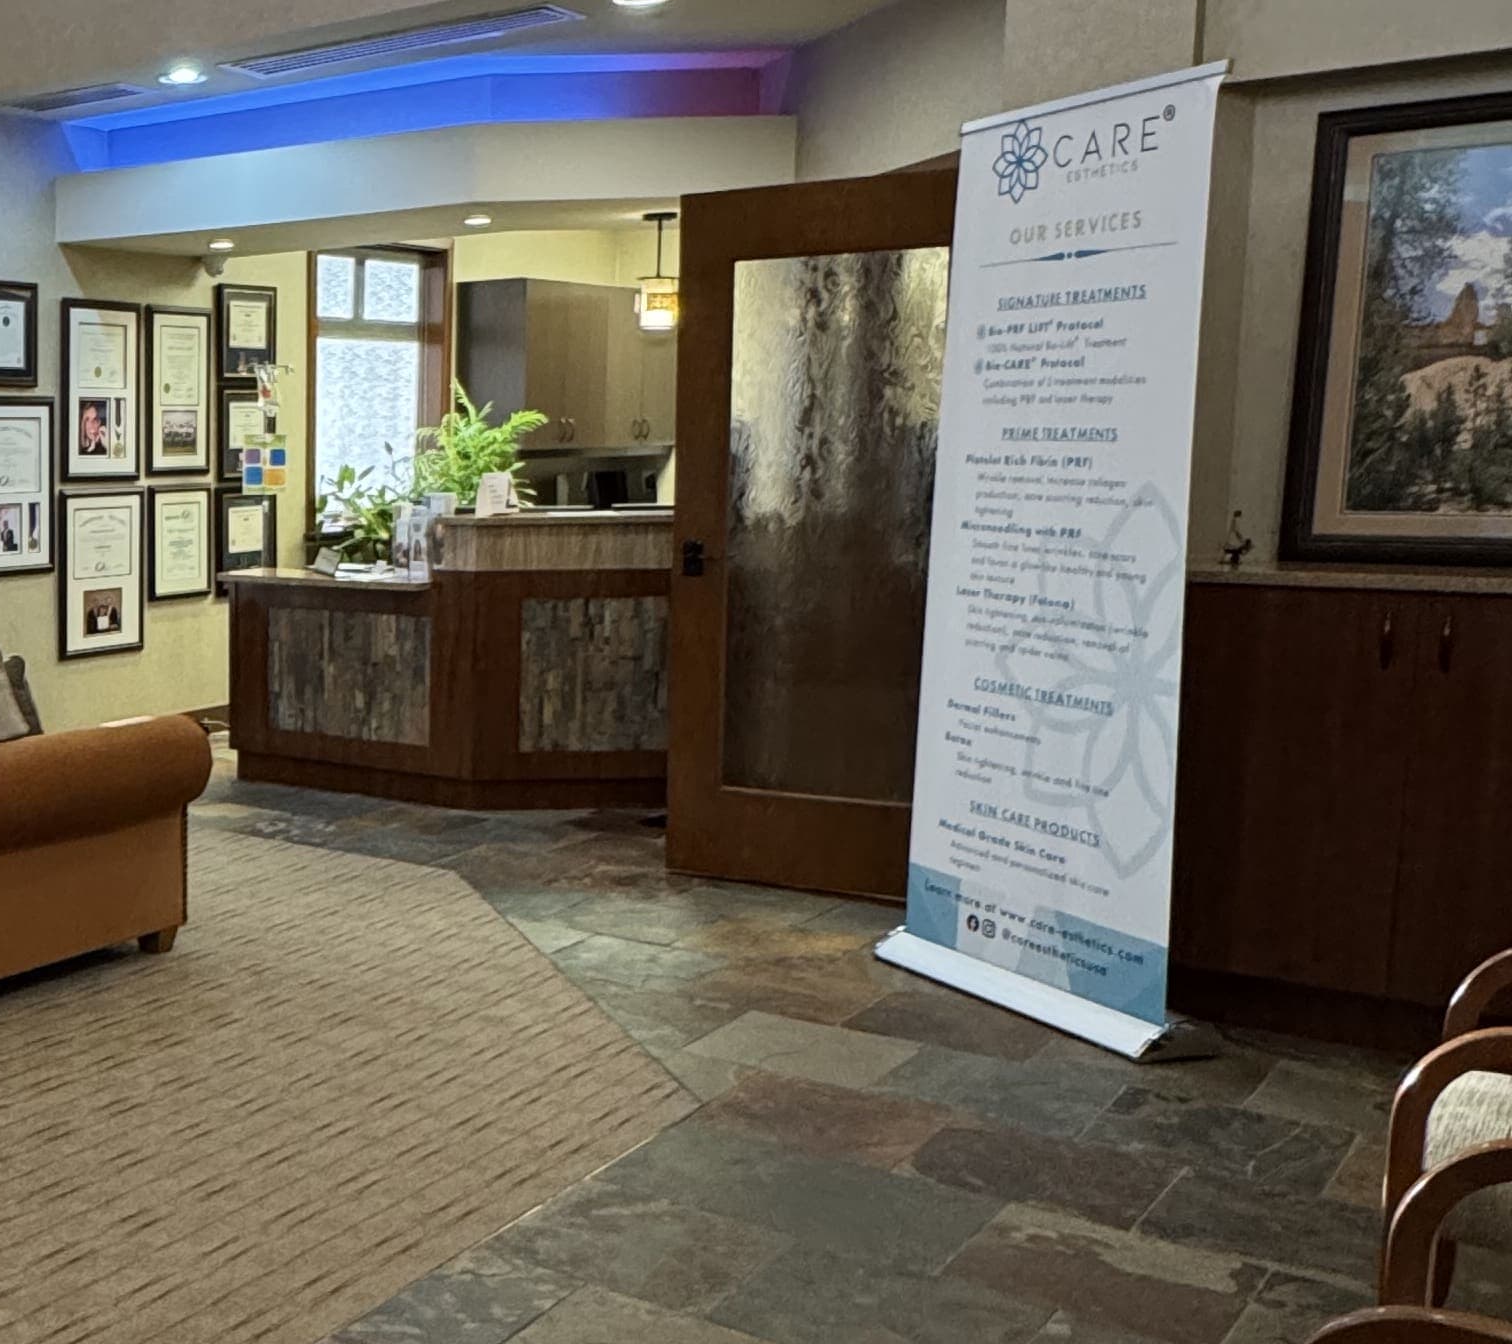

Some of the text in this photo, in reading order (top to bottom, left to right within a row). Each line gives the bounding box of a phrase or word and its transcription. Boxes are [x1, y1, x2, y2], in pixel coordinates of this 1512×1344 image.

[1066, 160, 1138, 183] ESTHETICS
[1009, 211, 1142, 245] OUR SERVICES
[997, 284, 1148, 311] SIGNATURE TREATMENTS
[1040, 356, 1086, 368] Protocol
[1001, 427, 1119, 443] PRIME TREATMENTS
[1004, 455, 1027, 466] Rich
[1030, 455, 1058, 467] Fibrin
[1062, 455, 1093, 470] (PRF)
[1035, 526, 1056, 537] with
[1059, 527, 1082, 539] PRF
[956, 585, 981, 597] Laser
[983, 588, 1026, 606] Therapy
[974, 676, 1116, 718] COSMETIC TREATMENTS
[947, 698, 1016, 722] Dermal Fillers
[969, 800, 1101, 849] SKIN CARE PRODUCTS
[939, 819, 1066, 864] Medical Grade Skin Care
[925, 878, 952, 898] Learn
[954, 892, 981, 909] more
[984, 902, 997, 914] at
